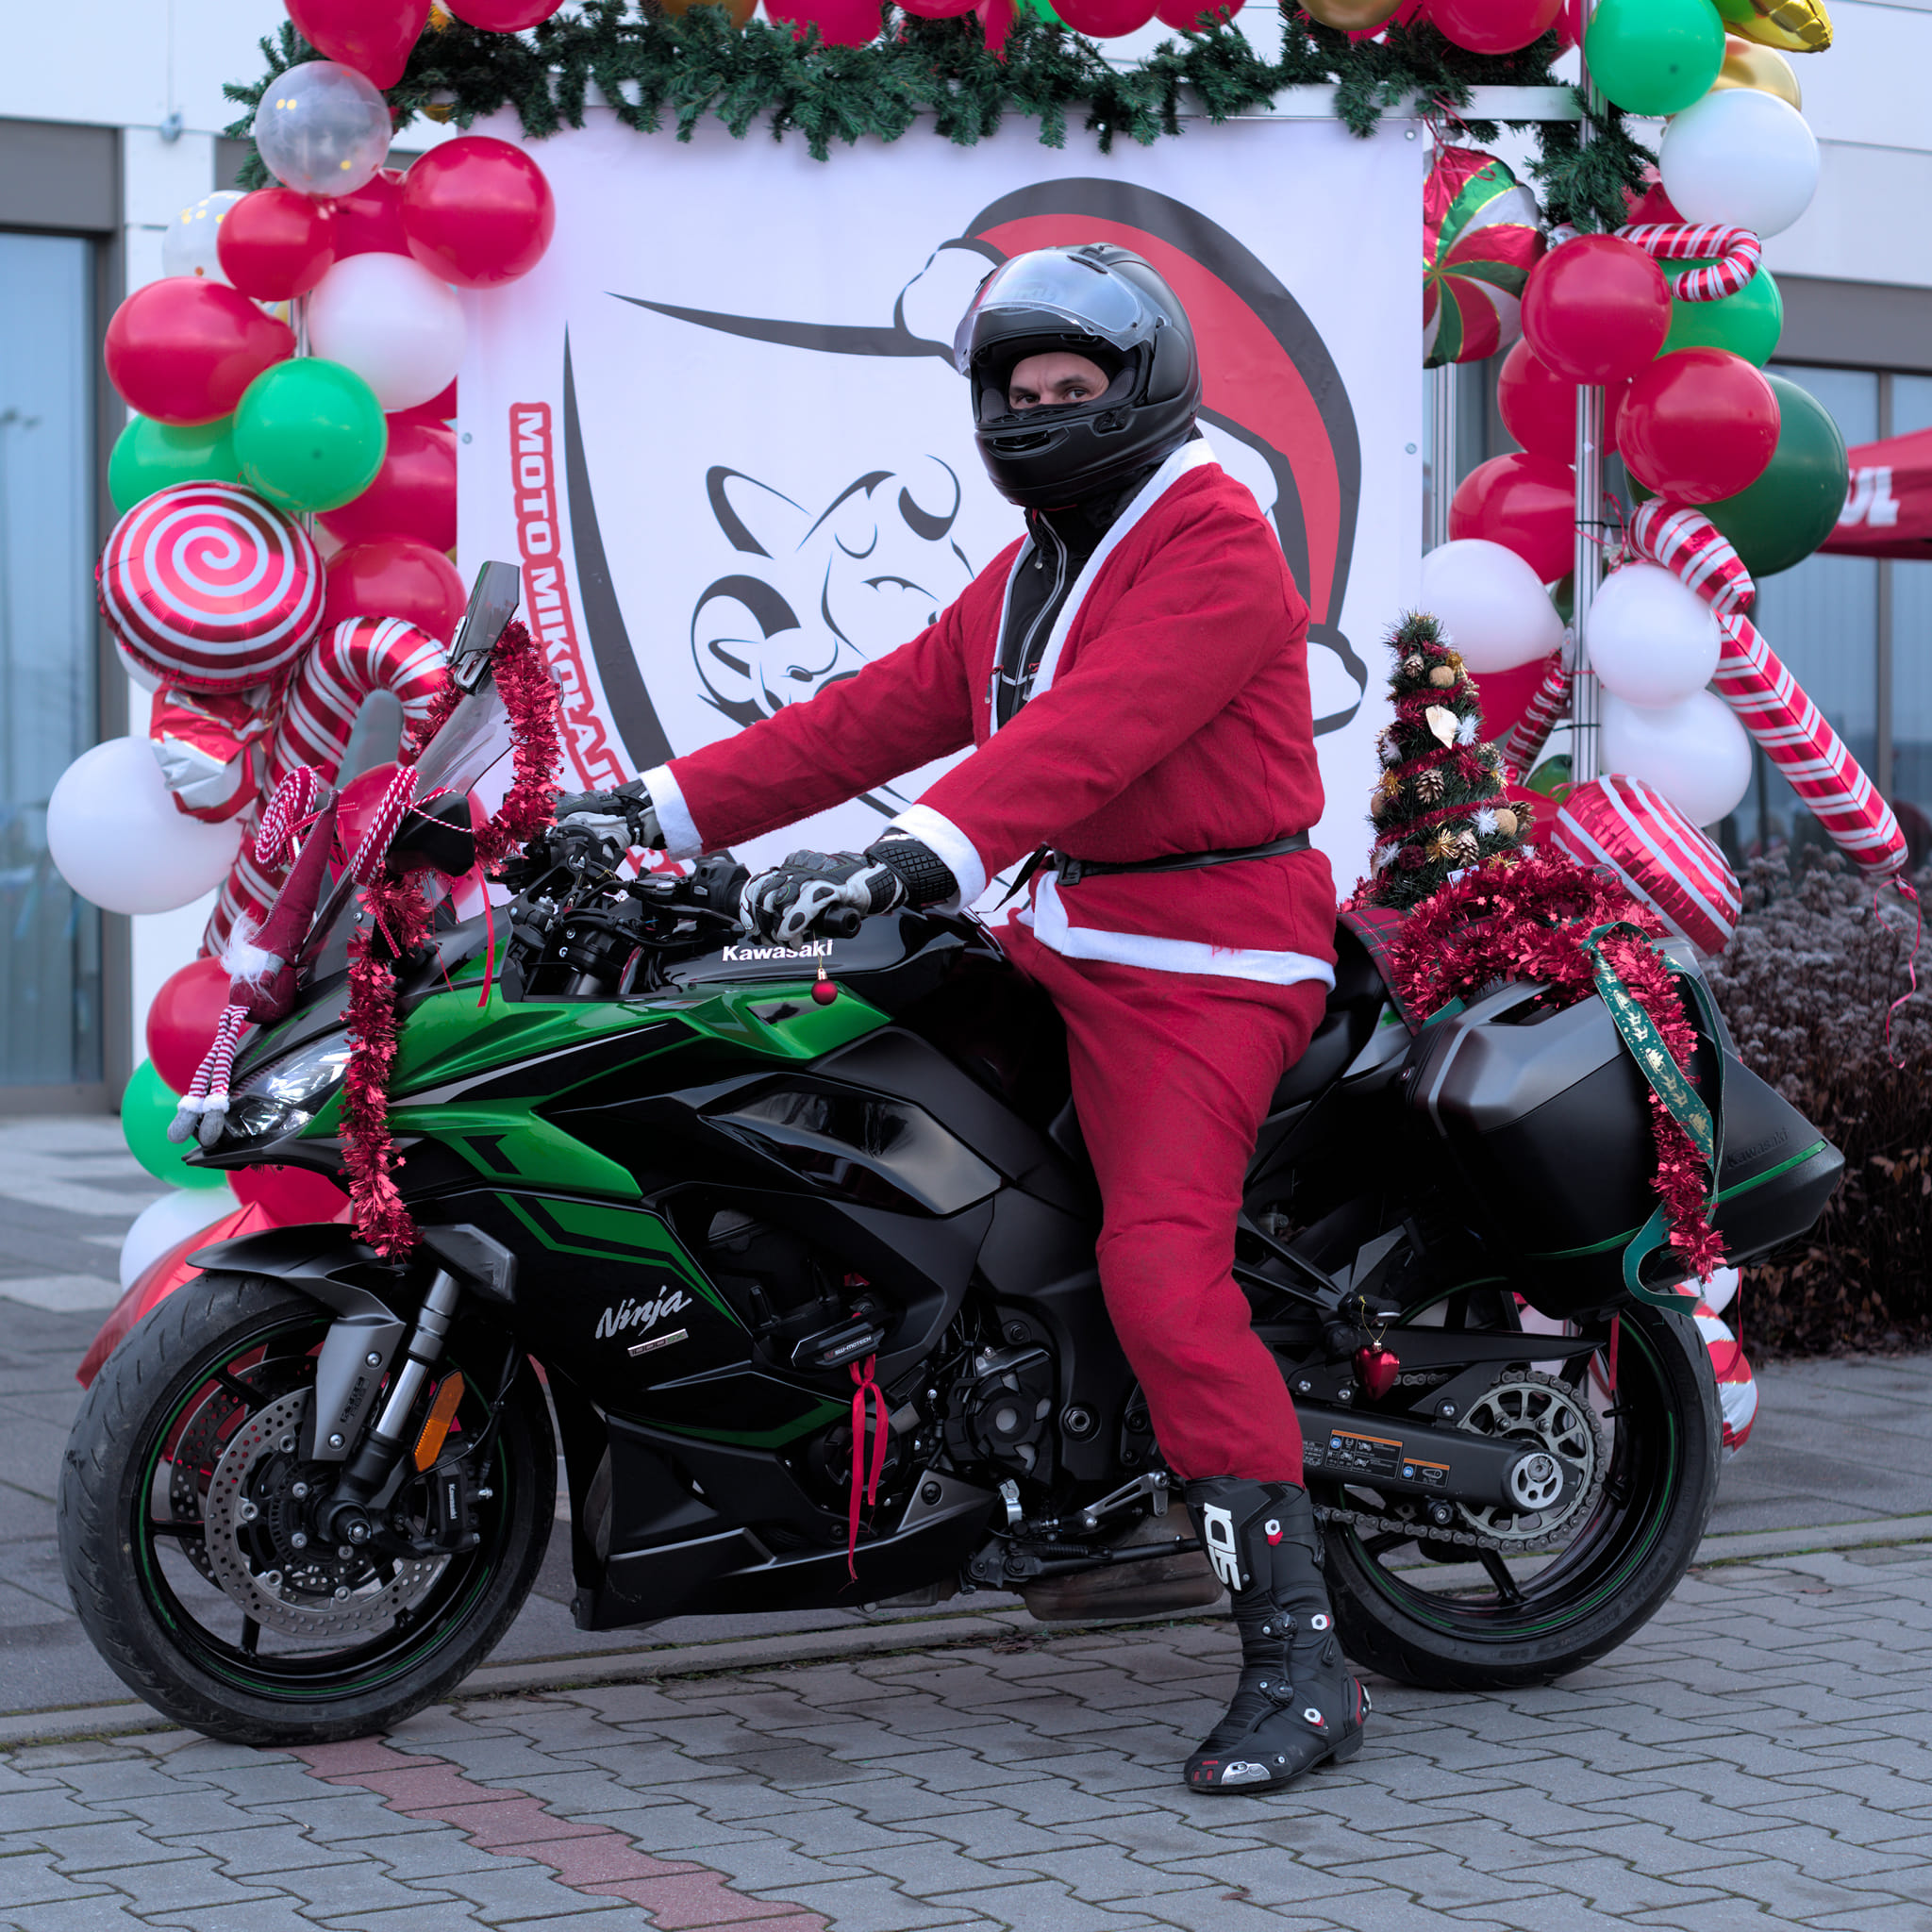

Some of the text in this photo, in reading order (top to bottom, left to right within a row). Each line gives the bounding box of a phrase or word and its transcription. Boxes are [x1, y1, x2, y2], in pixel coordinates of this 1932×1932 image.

[515, 408, 555, 557] MOTO
[722, 939, 833, 961] Kawasaki
[595, 1285, 692, 1340] Ninja
